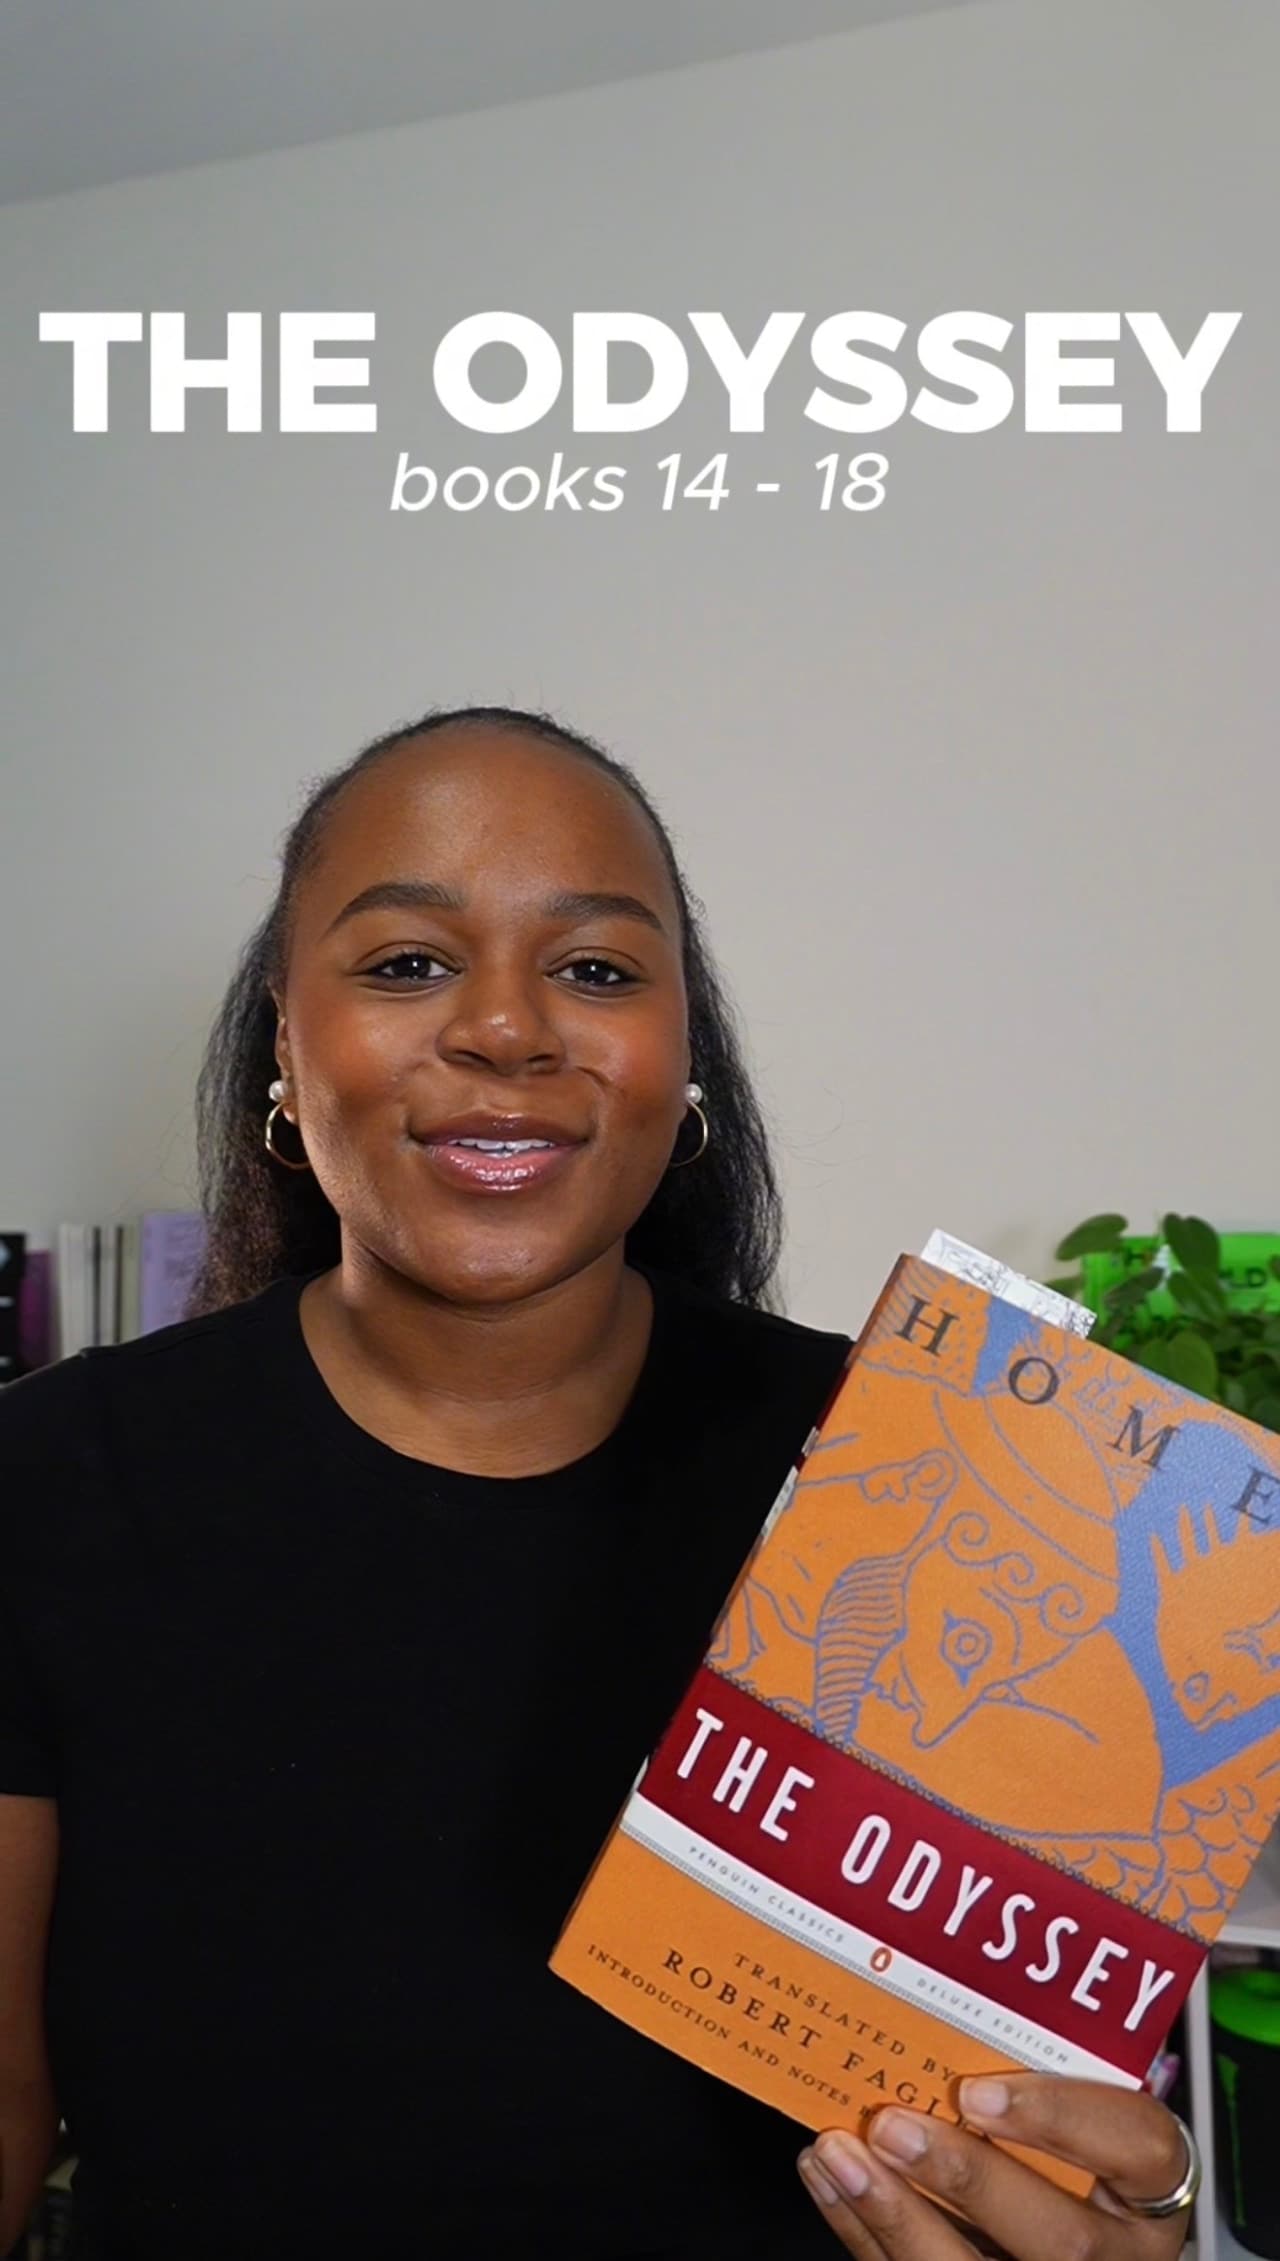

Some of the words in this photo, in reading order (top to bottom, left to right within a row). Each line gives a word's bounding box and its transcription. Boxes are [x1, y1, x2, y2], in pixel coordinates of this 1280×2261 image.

[677, 1707, 815, 1841] THE
[841, 1815, 1175, 2031] ODYSSEY
[689, 1846, 759, 1894] PENGUIN
[767, 1895, 845, 1943] CLASSICS
[587, 1944, 732, 2040] INTRODUCTION
[738, 2040, 780, 2067] AND
[787, 2065, 851, 2106] NOTES
[661, 1948, 823, 2049] ROBERT
[734, 1953, 906, 2056] TRANSLATED
[922, 2058, 957, 2082] BY
[917, 1978, 982, 2017] DELUXE
[994, 2018, 1069, 2063] EDITION
